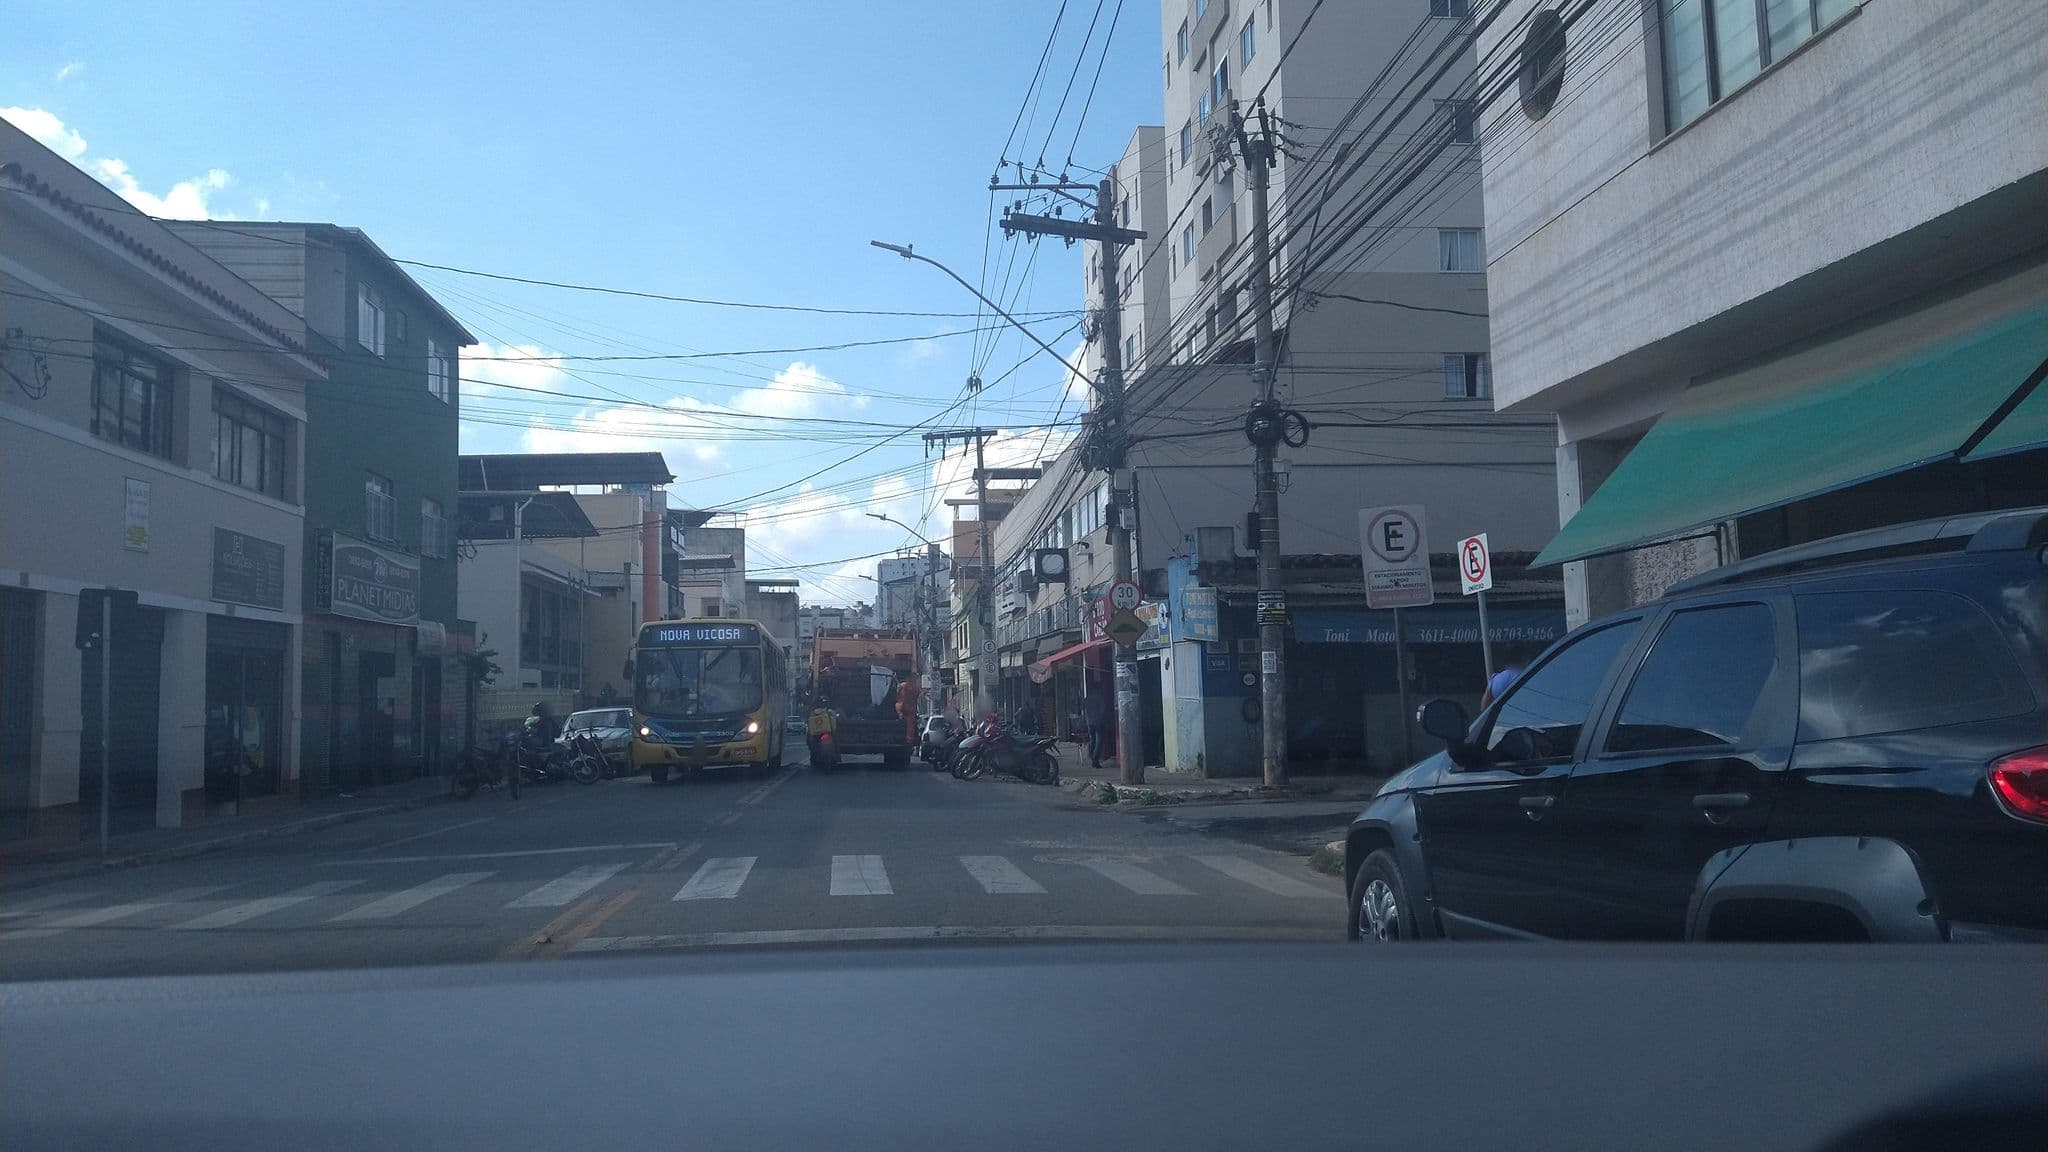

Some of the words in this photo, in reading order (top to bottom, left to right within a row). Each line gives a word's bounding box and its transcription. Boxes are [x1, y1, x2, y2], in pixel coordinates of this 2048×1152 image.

[1384, 521, 1405, 551] E
[338, 579, 382, 607] PLANET
[1118, 587, 1133, 598] 30
[660, 629, 690, 641] NOVA
[1325, 628, 1350, 642] Toni
[1417, 628, 1478, 642] 3611-4000
